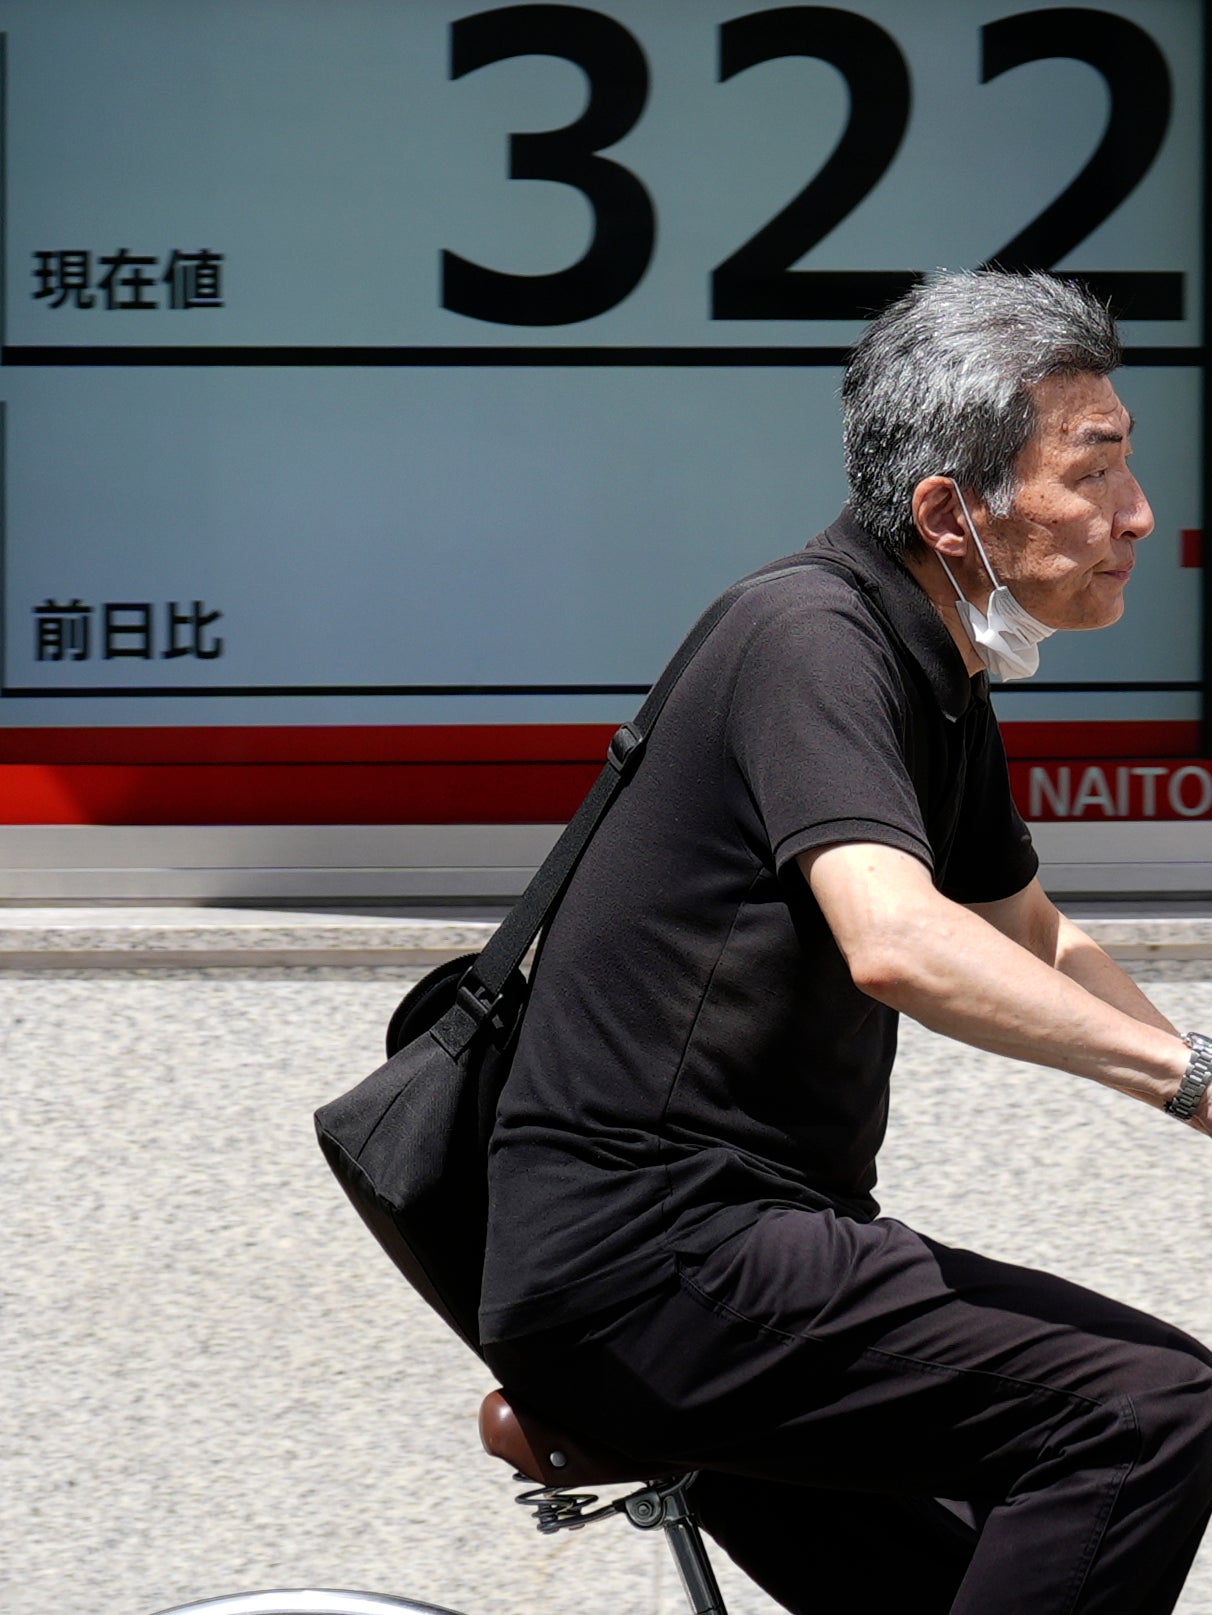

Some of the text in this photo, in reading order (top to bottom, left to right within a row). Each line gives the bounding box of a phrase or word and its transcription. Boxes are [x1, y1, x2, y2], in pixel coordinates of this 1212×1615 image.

[32, 248, 225, 310] 現在値
[32, 598, 224, 661] 前日比
